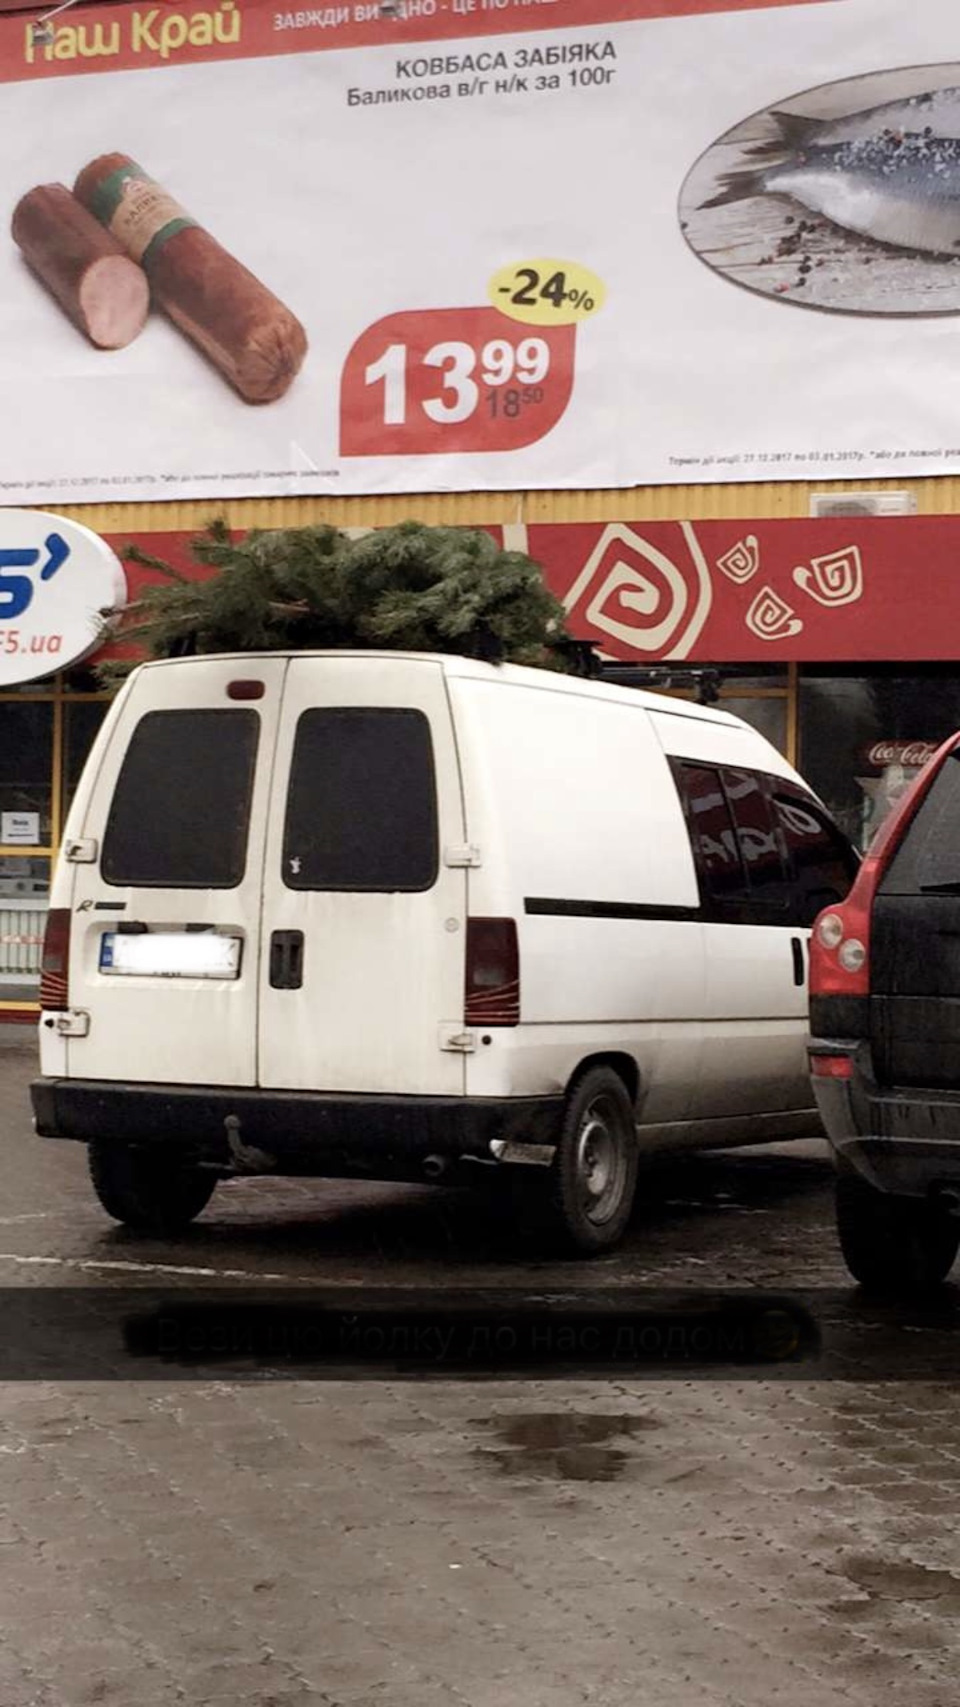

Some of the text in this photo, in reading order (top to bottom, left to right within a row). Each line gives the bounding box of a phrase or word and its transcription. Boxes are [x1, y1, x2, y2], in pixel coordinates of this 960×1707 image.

[25, 2, 241, 63] Наш Край
[273, 7, 349, 31] ЗАВЖДИ
[453, 0, 476, 15] ЦЕ
[395, 41, 617, 79] КОВБАСА ЗАБІЯКА
[347, 66, 617, 107] Баликова в/г н/к за 100г
[497, 268, 595, 312] -24%
